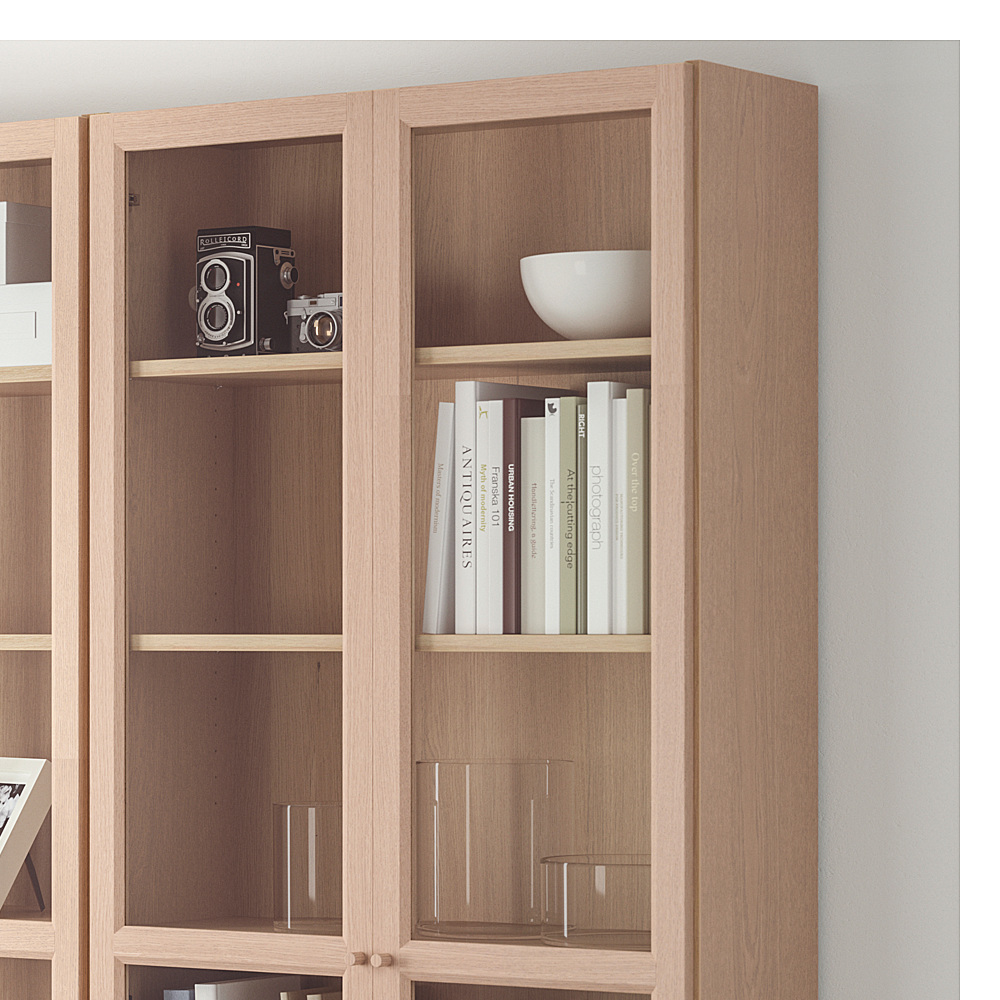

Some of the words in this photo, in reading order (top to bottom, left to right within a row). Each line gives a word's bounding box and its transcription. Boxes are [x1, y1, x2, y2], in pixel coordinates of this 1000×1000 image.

[200, 236, 248, 246] ROLLEICORD
[578, 413, 586, 438] RIGHT
[436, 463, 444, 489] Masters
[479, 464, 487, 483] Myth
[566, 469, 576, 481] At
[631, 452, 641, 476] Over
[435, 489, 442, 498] of
[480, 484, 487, 492] of
[491, 466, 501, 506] Franska
[566, 484, 576, 500] the
[631, 479, 641, 494] the
[432, 498, 441, 534] modernism
[459, 445, 473, 569] ANTIQUAIRES
[479, 494, 487, 532] modernity
[589, 465, 604, 550] photograph
[629, 496, 640, 512] top
[491, 509, 501, 527] 101
[564, 503, 576, 540] cutting
[564, 541, 576, 569] edge
